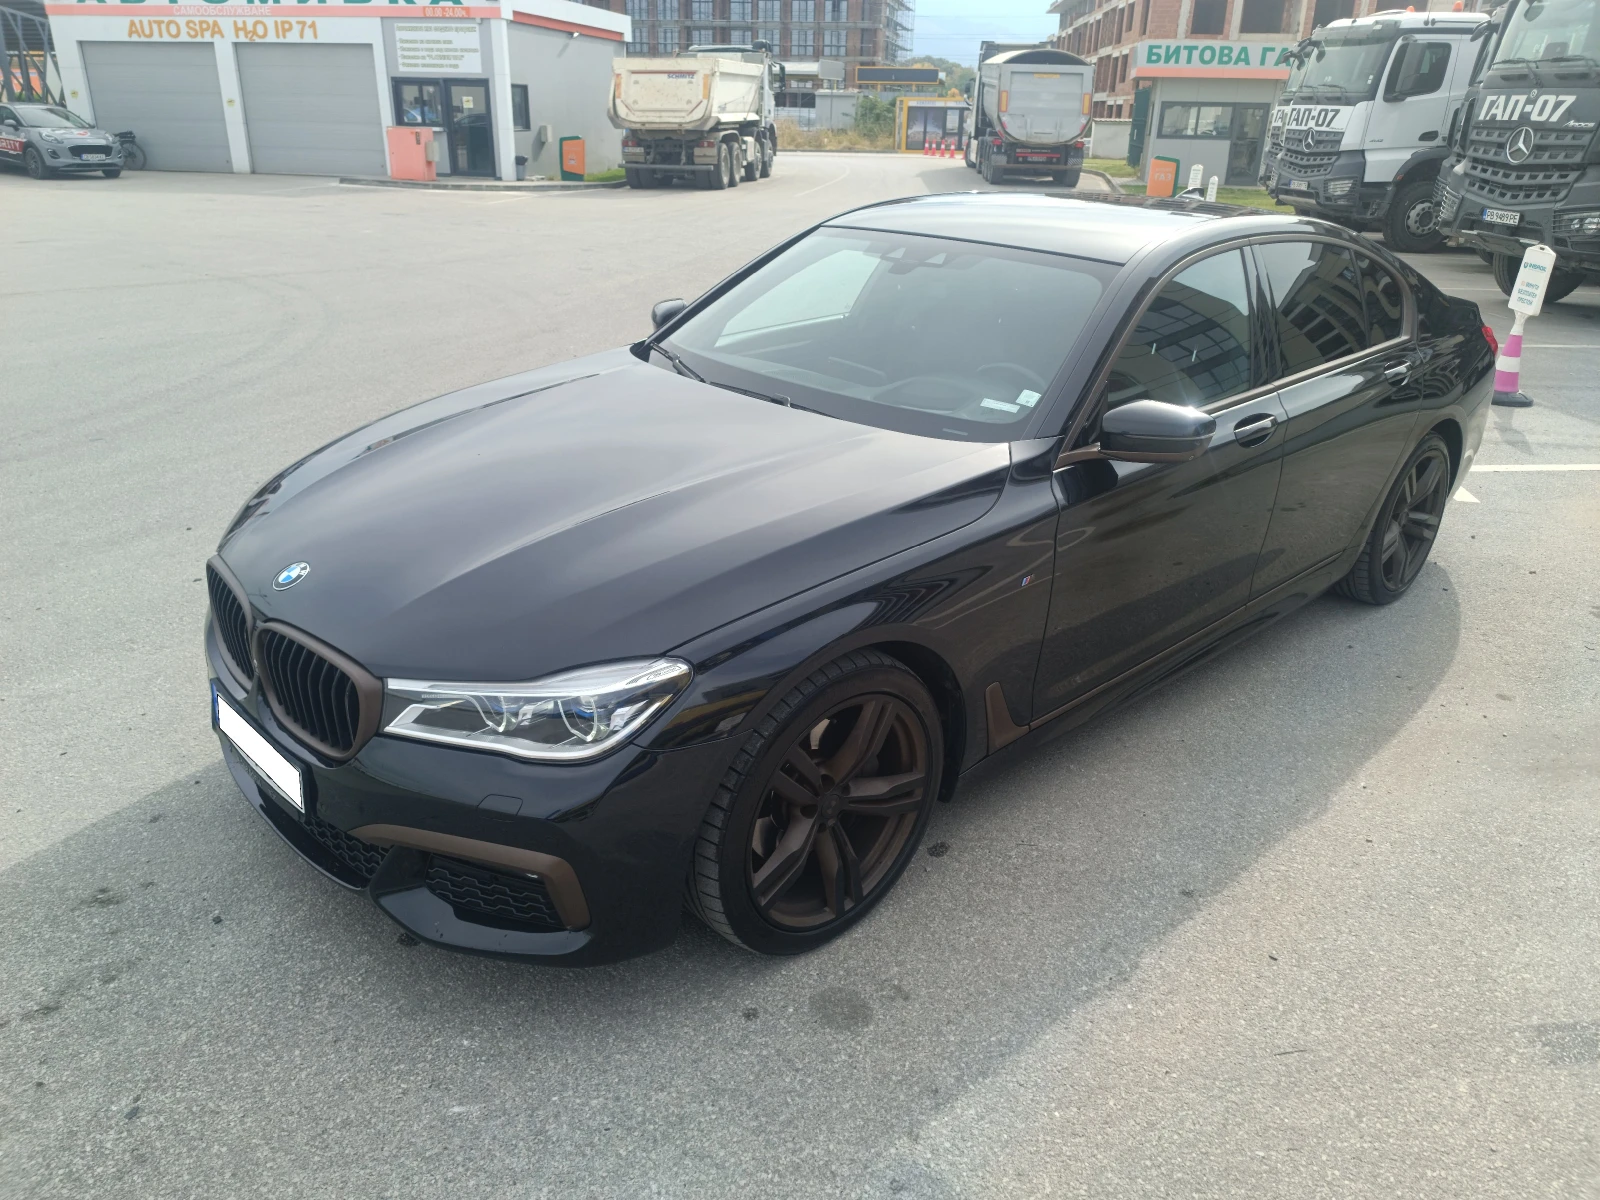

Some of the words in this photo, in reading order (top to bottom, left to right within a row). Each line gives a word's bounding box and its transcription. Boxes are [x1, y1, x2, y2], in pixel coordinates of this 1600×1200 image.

[127, 19, 181, 39] AUTO
[186, 20, 224, 39] SPA
[1146, 44, 1251, 65] БИТОВА
[1259, 47, 1292, 67] ГА
[1287, 107, 1341, 128] ГАП-07
[1478, 94, 1577, 122] ГАП-07
